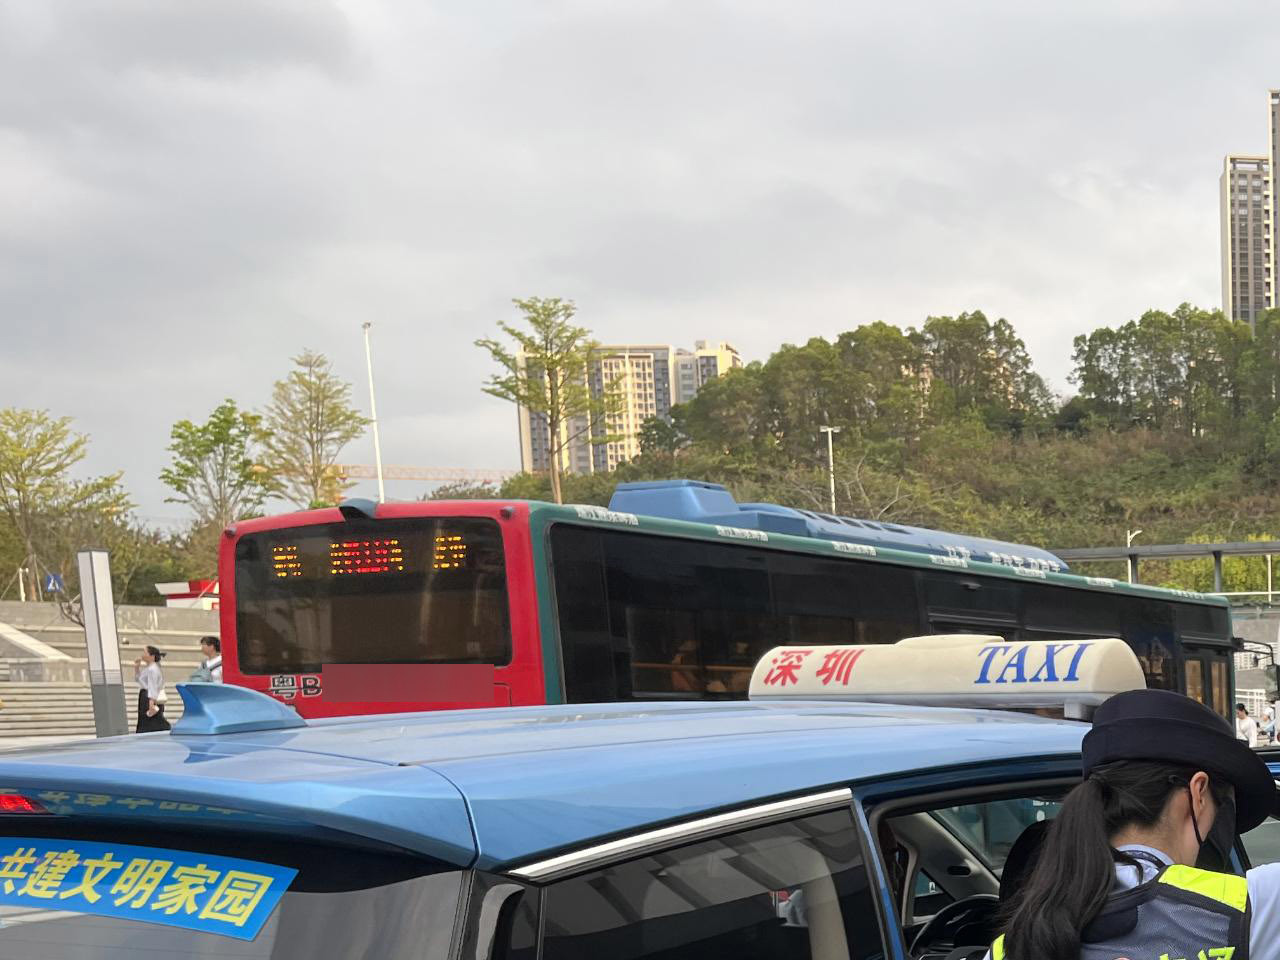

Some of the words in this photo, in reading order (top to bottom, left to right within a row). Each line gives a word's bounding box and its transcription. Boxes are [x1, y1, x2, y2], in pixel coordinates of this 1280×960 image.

[763, 649, 865, 686] 深圳
[974, 642, 1094, 684] TAXI
[0, 847, 274, 927] 共建文明家园
